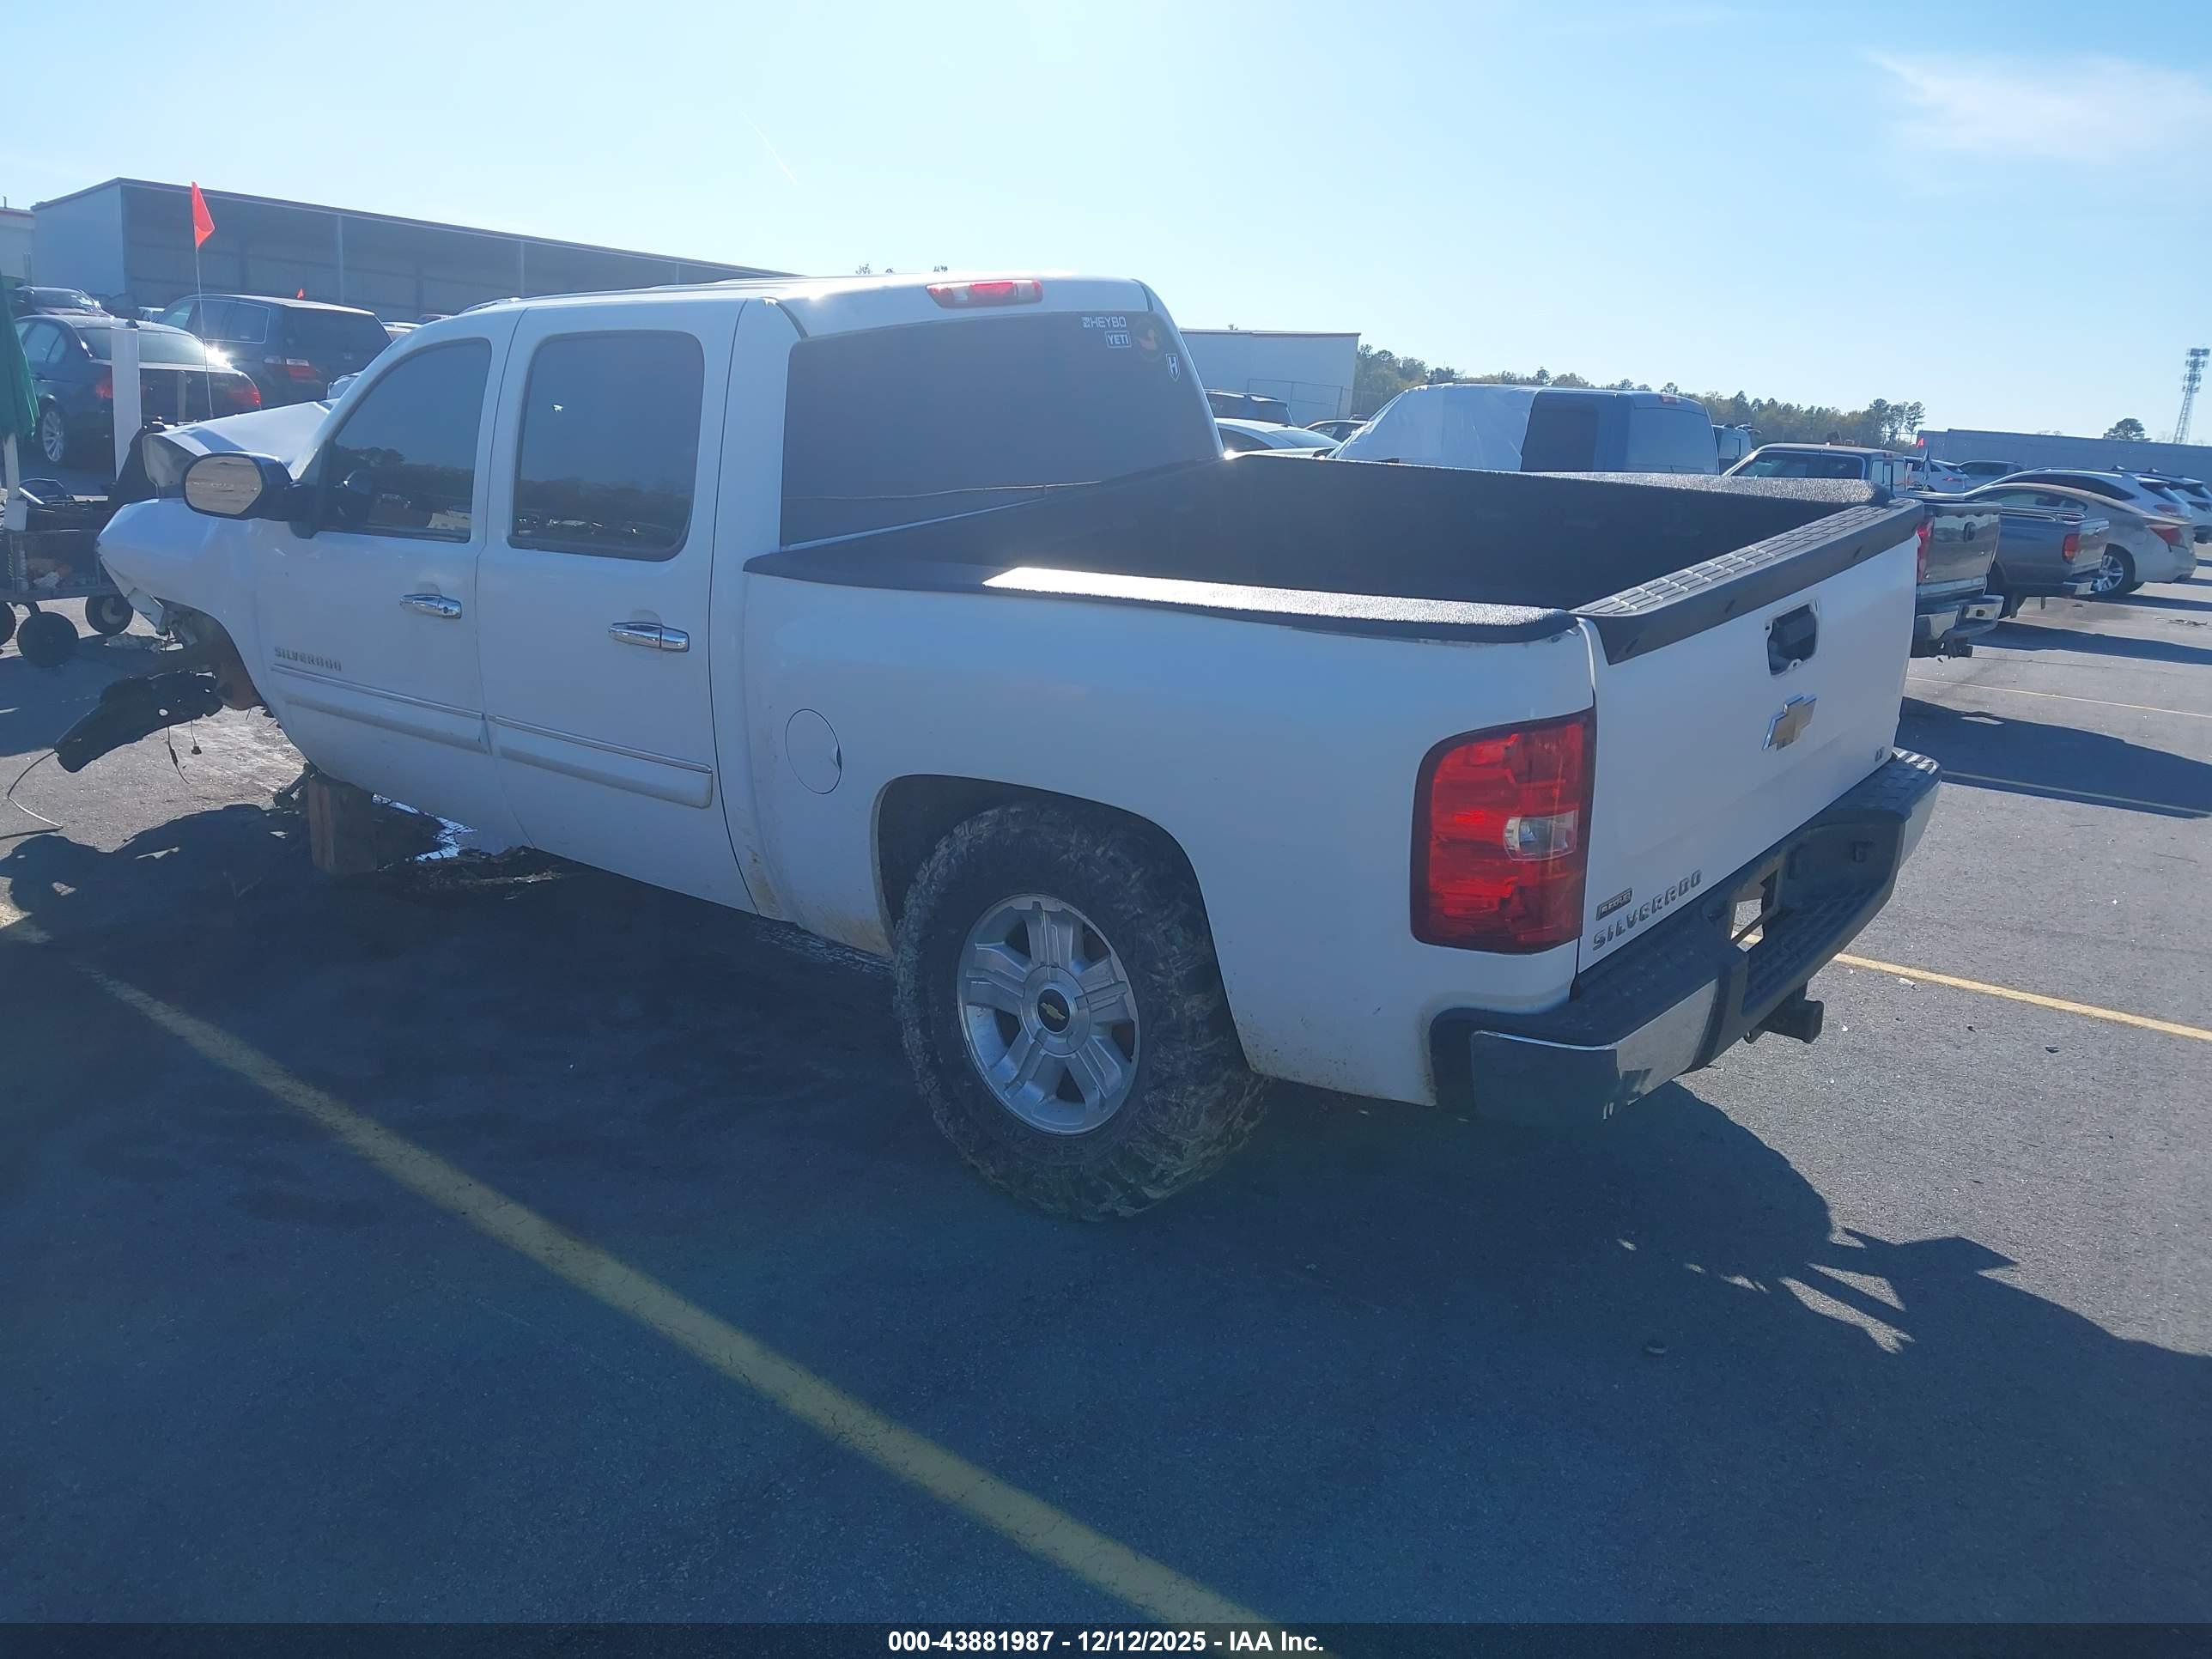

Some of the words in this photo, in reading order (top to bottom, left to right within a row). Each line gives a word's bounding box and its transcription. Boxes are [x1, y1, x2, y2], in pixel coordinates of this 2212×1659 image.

[1090, 316, 1127, 328] HEYBO
[1107, 334, 1129, 345] YETI
[1592, 869, 1703, 951] SILVERADO
